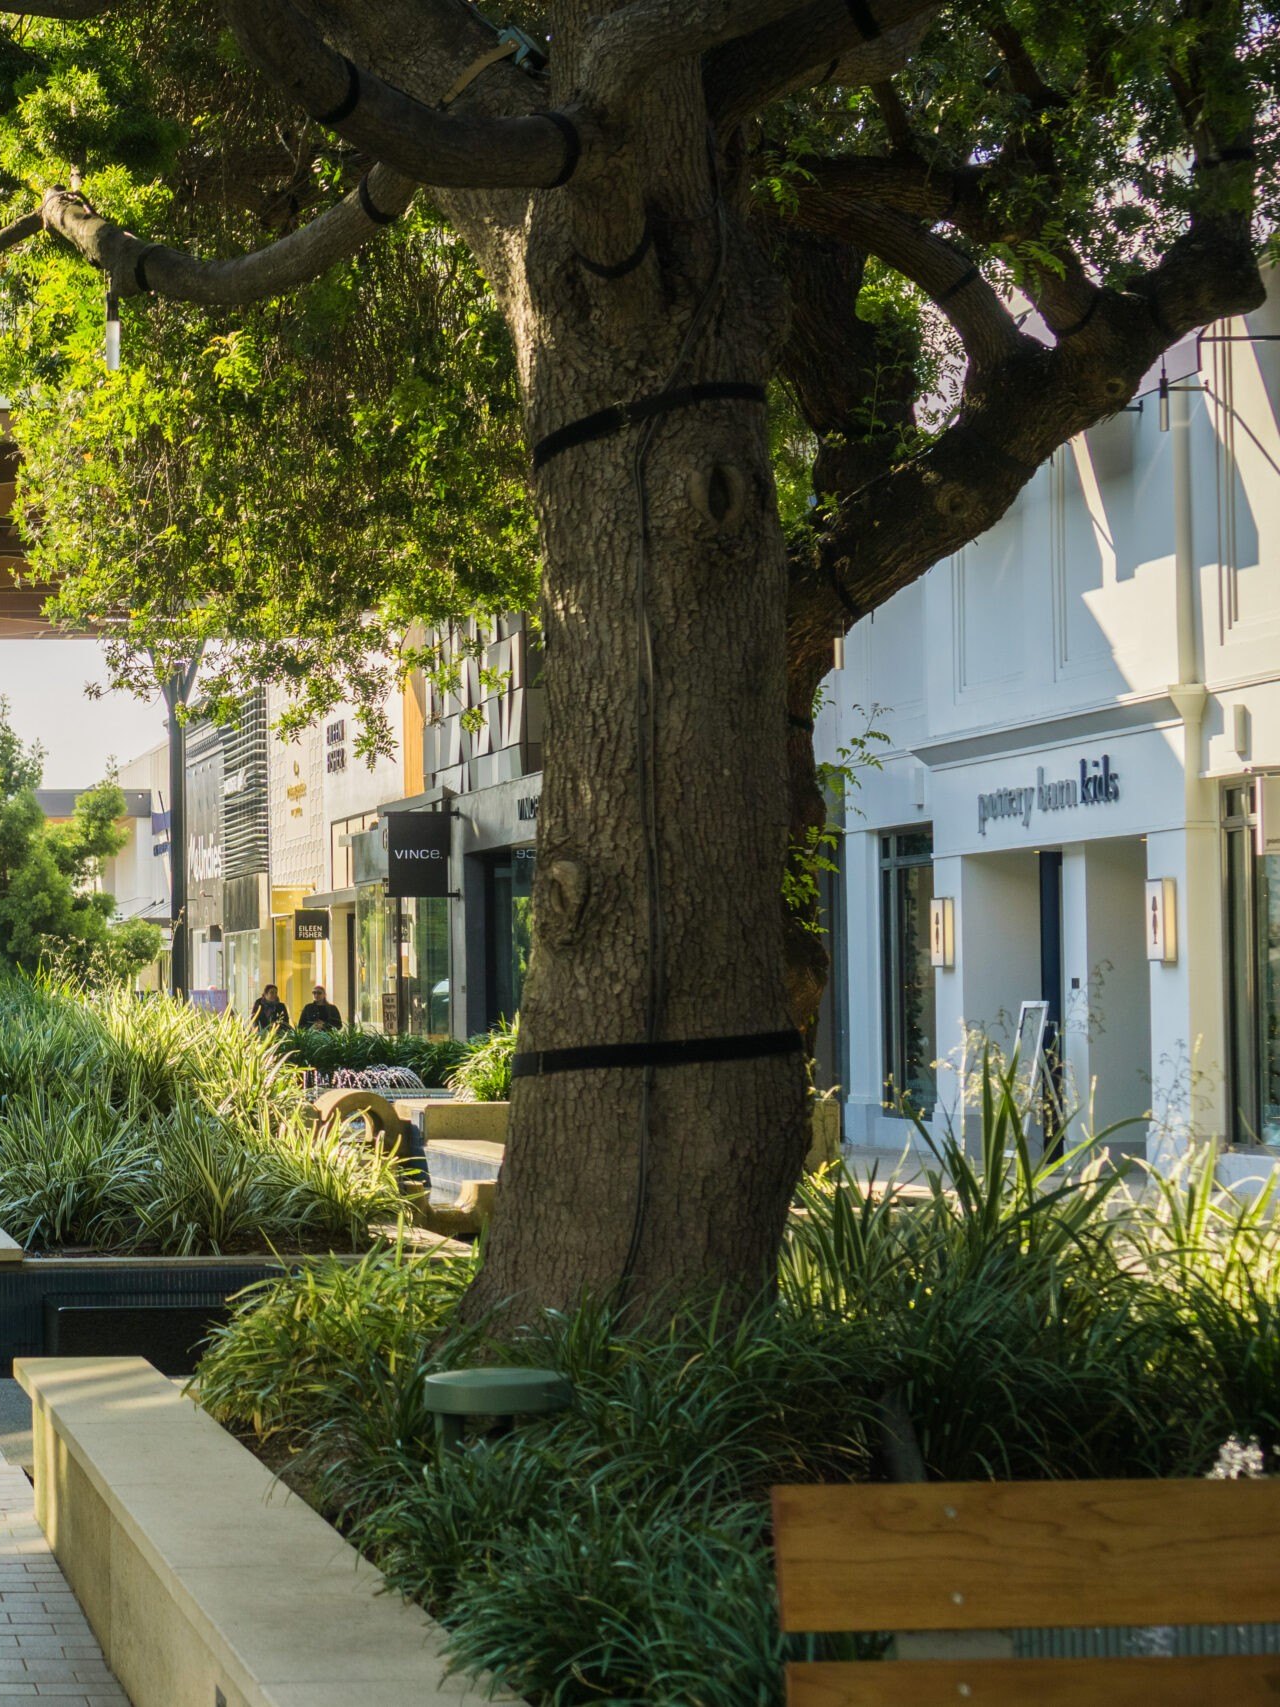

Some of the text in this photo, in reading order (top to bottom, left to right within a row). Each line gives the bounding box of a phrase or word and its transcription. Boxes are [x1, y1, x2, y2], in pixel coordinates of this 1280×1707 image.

[326, 719, 345, 746] EILEEN
[326, 747, 345, 774] FISHER
[977, 754, 1120, 836] pottery barn kids
